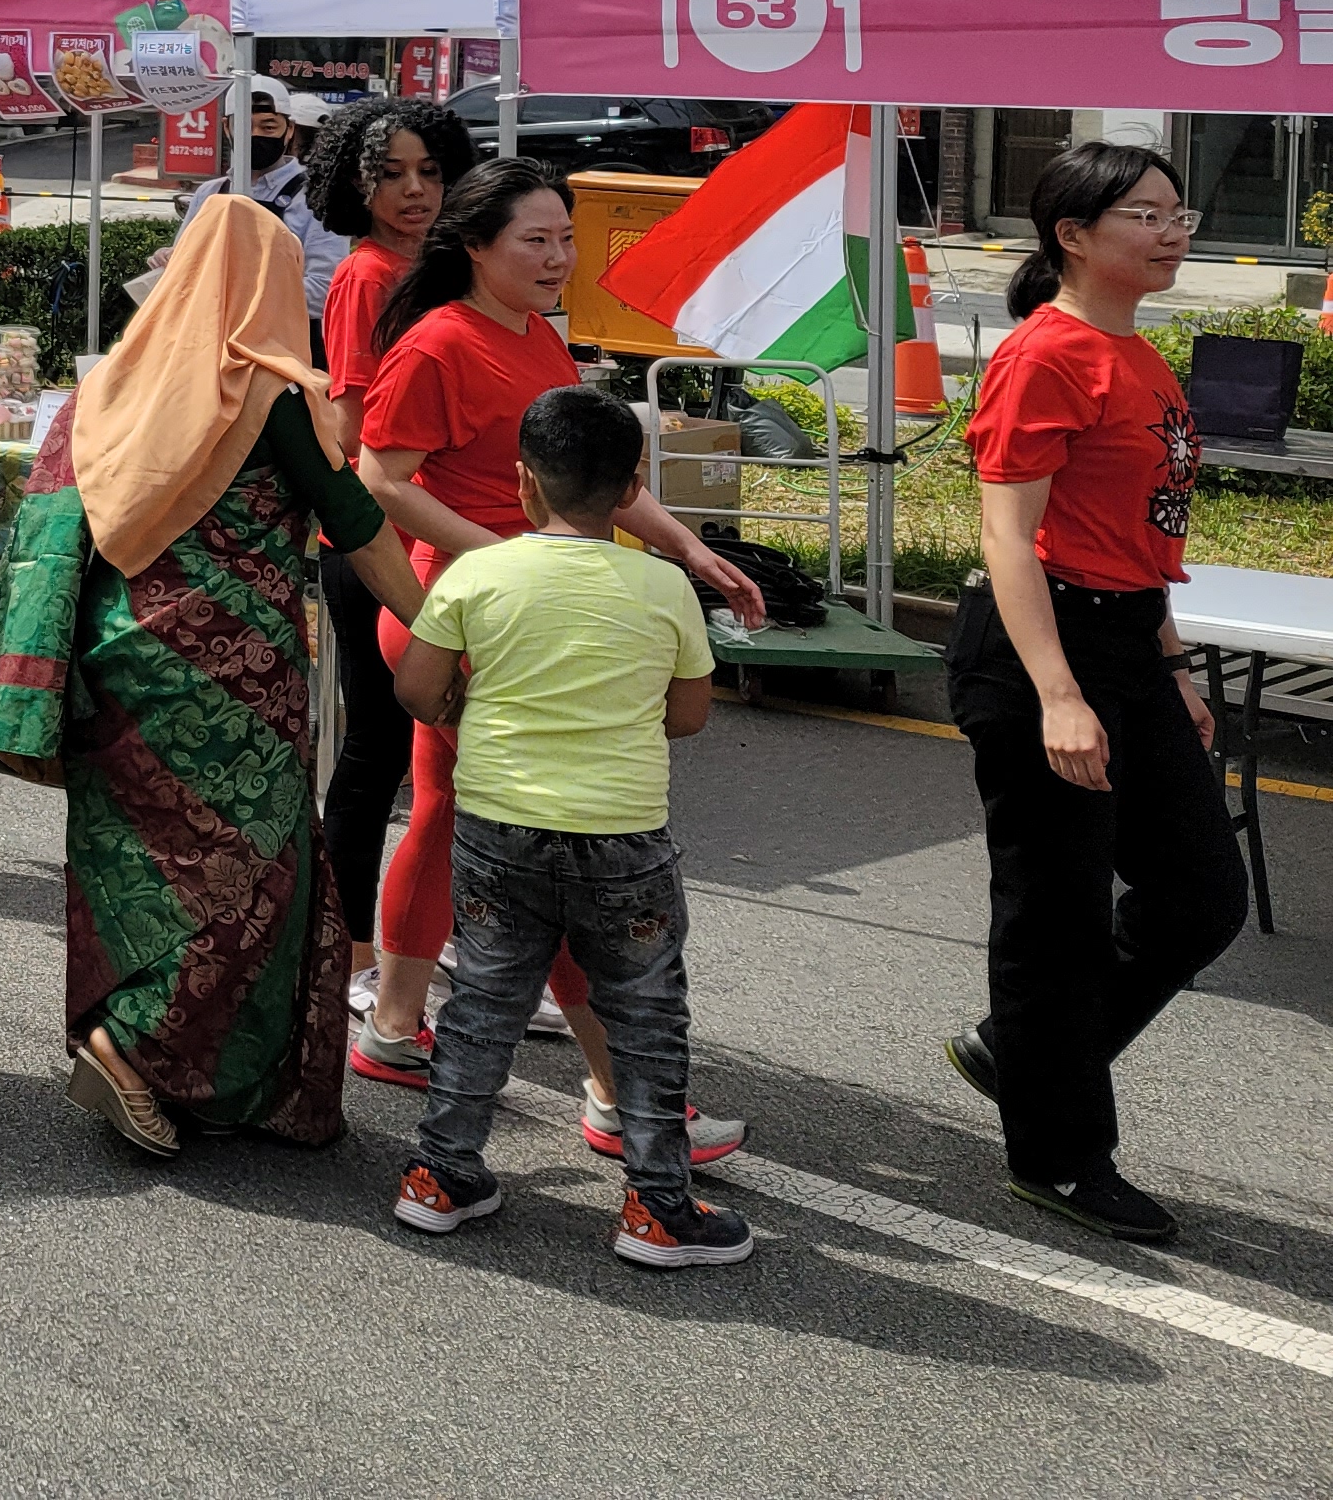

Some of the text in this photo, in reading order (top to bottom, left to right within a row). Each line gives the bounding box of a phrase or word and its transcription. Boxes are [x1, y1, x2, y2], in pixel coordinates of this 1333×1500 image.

[139, 43, 193, 55] 카드결제가능
[141, 65, 196, 77] 카드결제가능
[269, 59, 369, 80] 3672-8949
[148, 83, 208, 95] 카드결제가능
